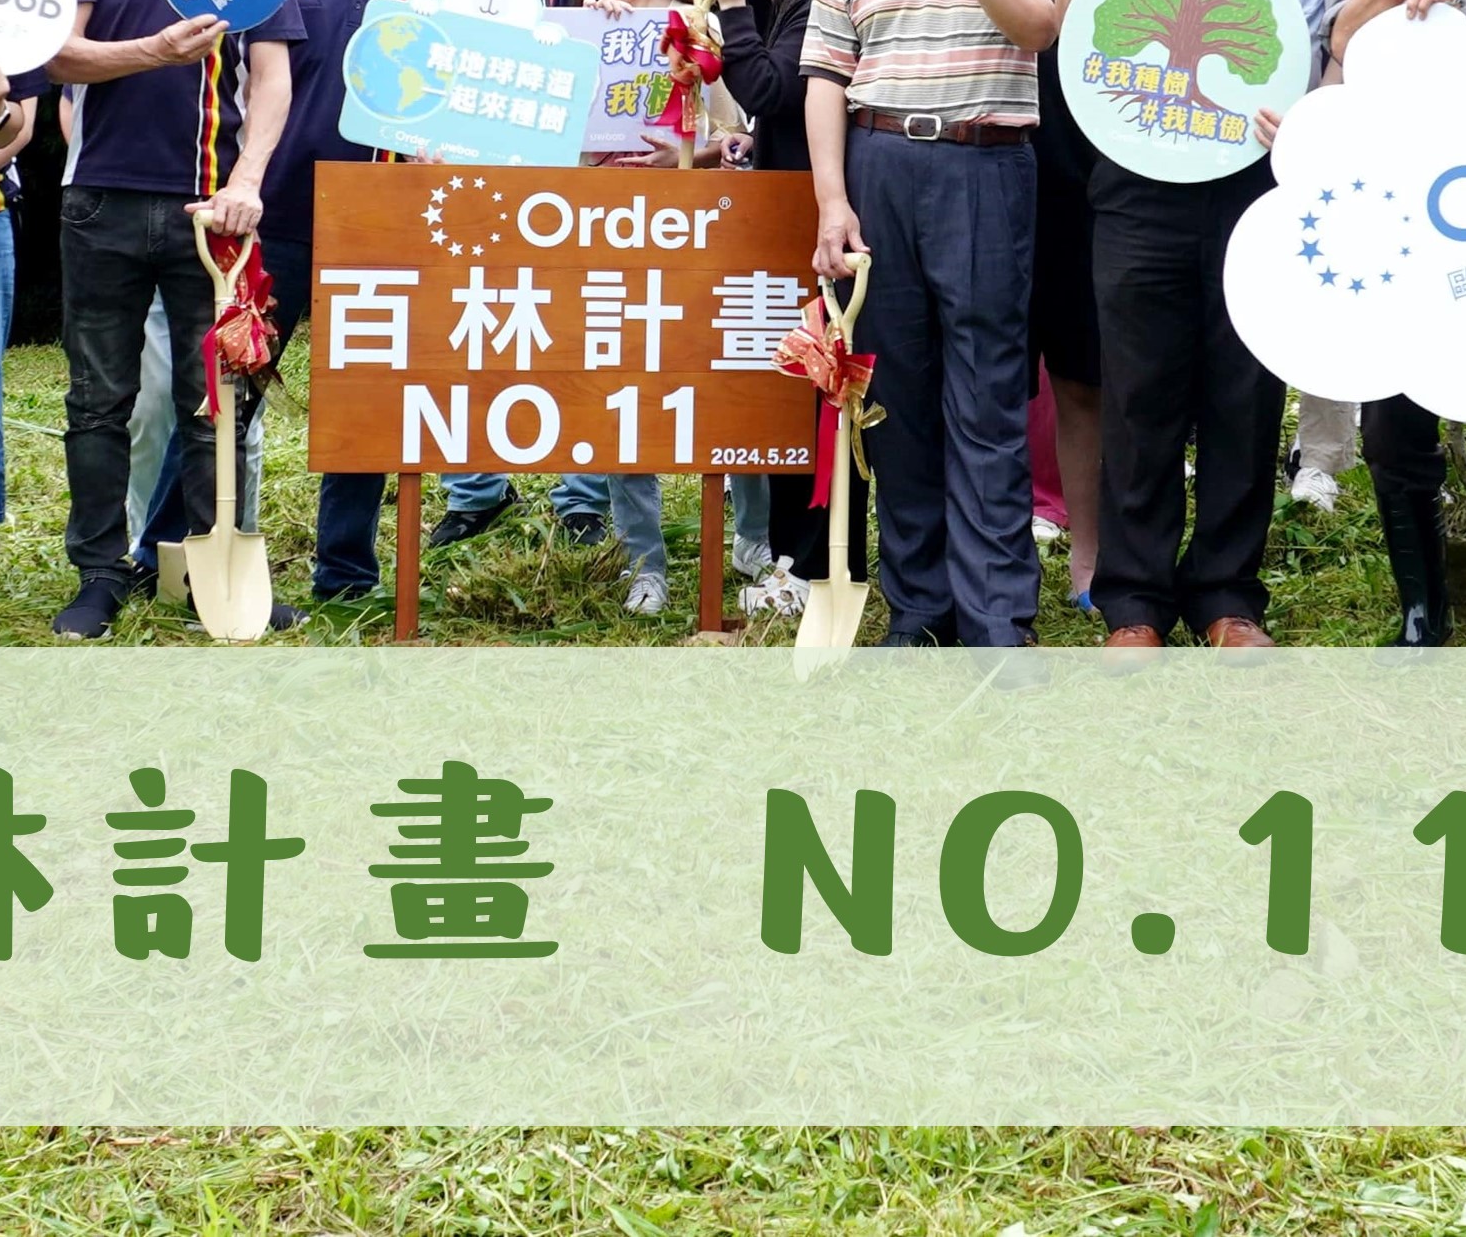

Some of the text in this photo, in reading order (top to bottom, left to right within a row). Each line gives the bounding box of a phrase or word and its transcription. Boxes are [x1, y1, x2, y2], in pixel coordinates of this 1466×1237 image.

[1083, 52, 1191, 99] #我種樹
[1139, 98, 1250, 146] #我驕傲
[320, 266, 809, 372] 百林計畫
[401, 383, 695, 465] NO.11
[710, 447, 810, 466] 2024.5.22
